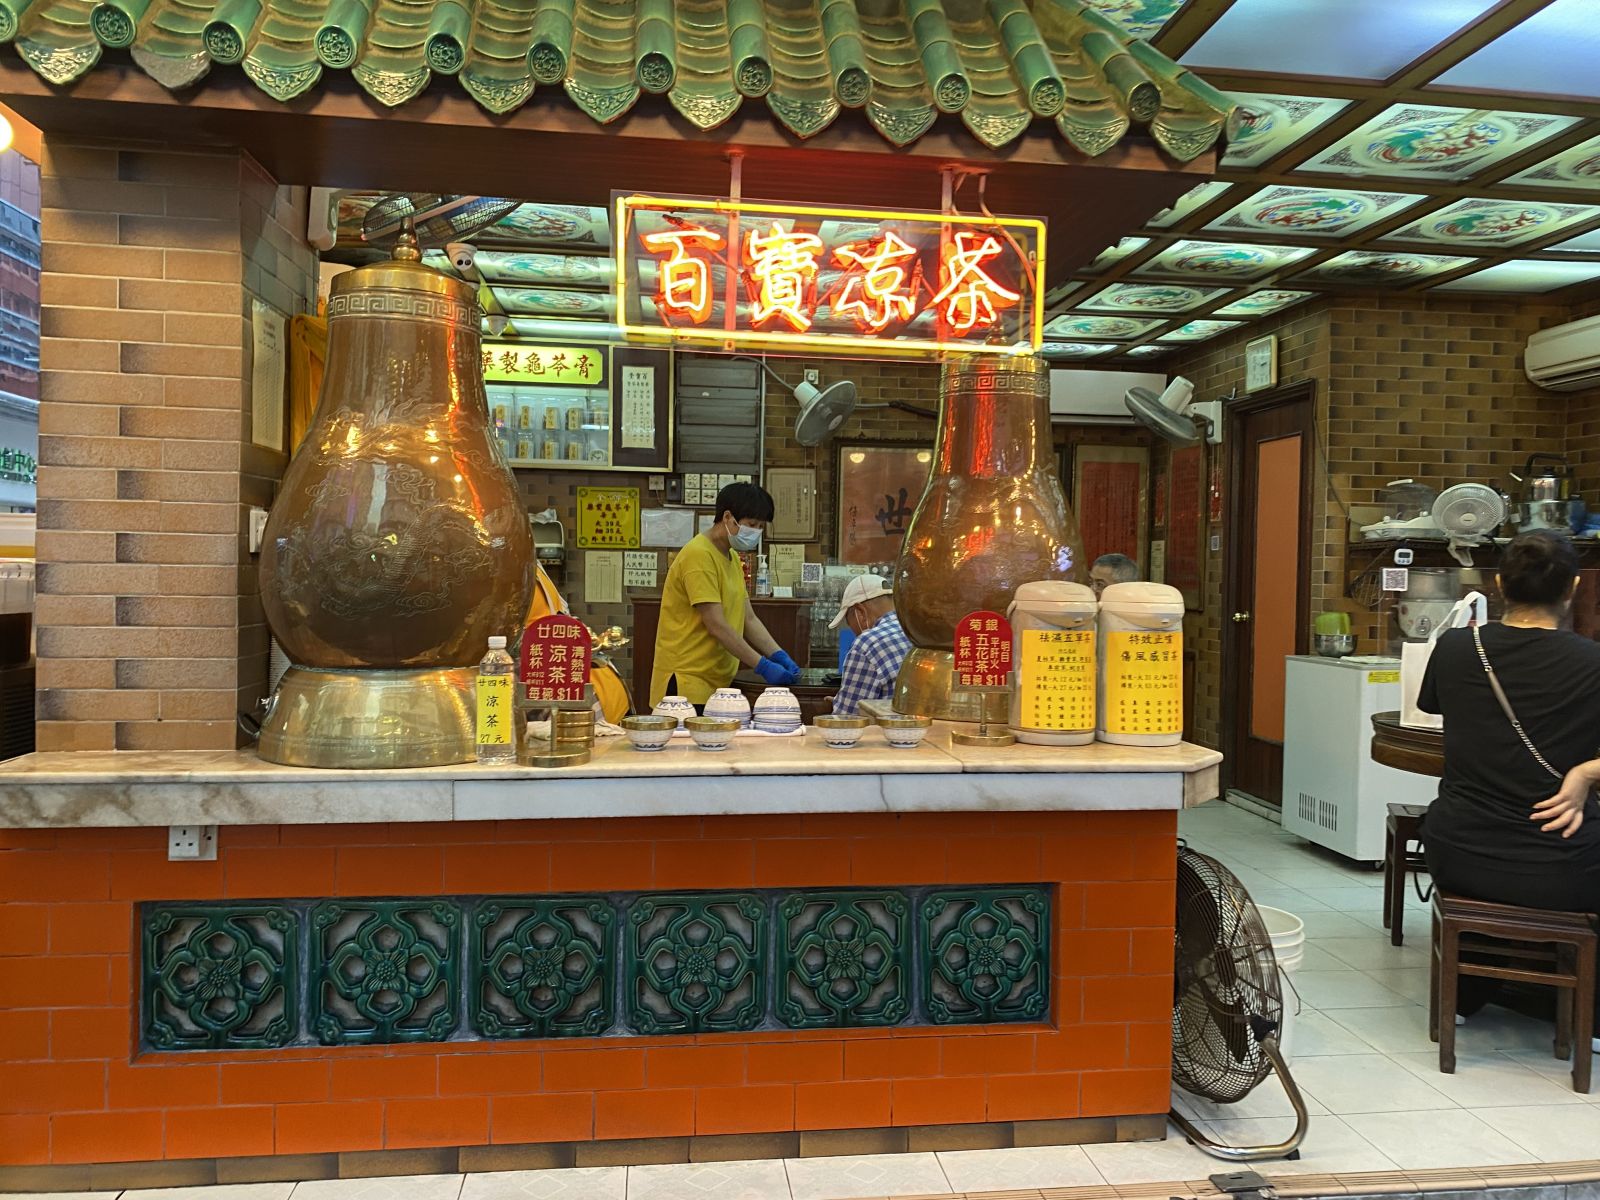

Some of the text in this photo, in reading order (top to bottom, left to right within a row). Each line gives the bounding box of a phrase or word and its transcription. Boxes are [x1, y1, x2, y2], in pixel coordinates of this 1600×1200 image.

[537, 624, 581, 639] 廿四味
[529, 643, 544, 669] 紙杯
[959, 636, 971, 659] 紙杯
[976, 633, 989, 673] 五花茶
[990, 637, 1000, 669] 平肝火
[1000, 641, 1010, 662] 明目
[548, 644, 567, 684] 涼茶
[570, 646, 585, 683] 清熱氣
[478, 678, 509, 687] 廿四味
[986, 674, 1006, 686] $11
[529, 687, 580, 701] 每碗 $11
[486, 696, 499, 728] 涼茶
